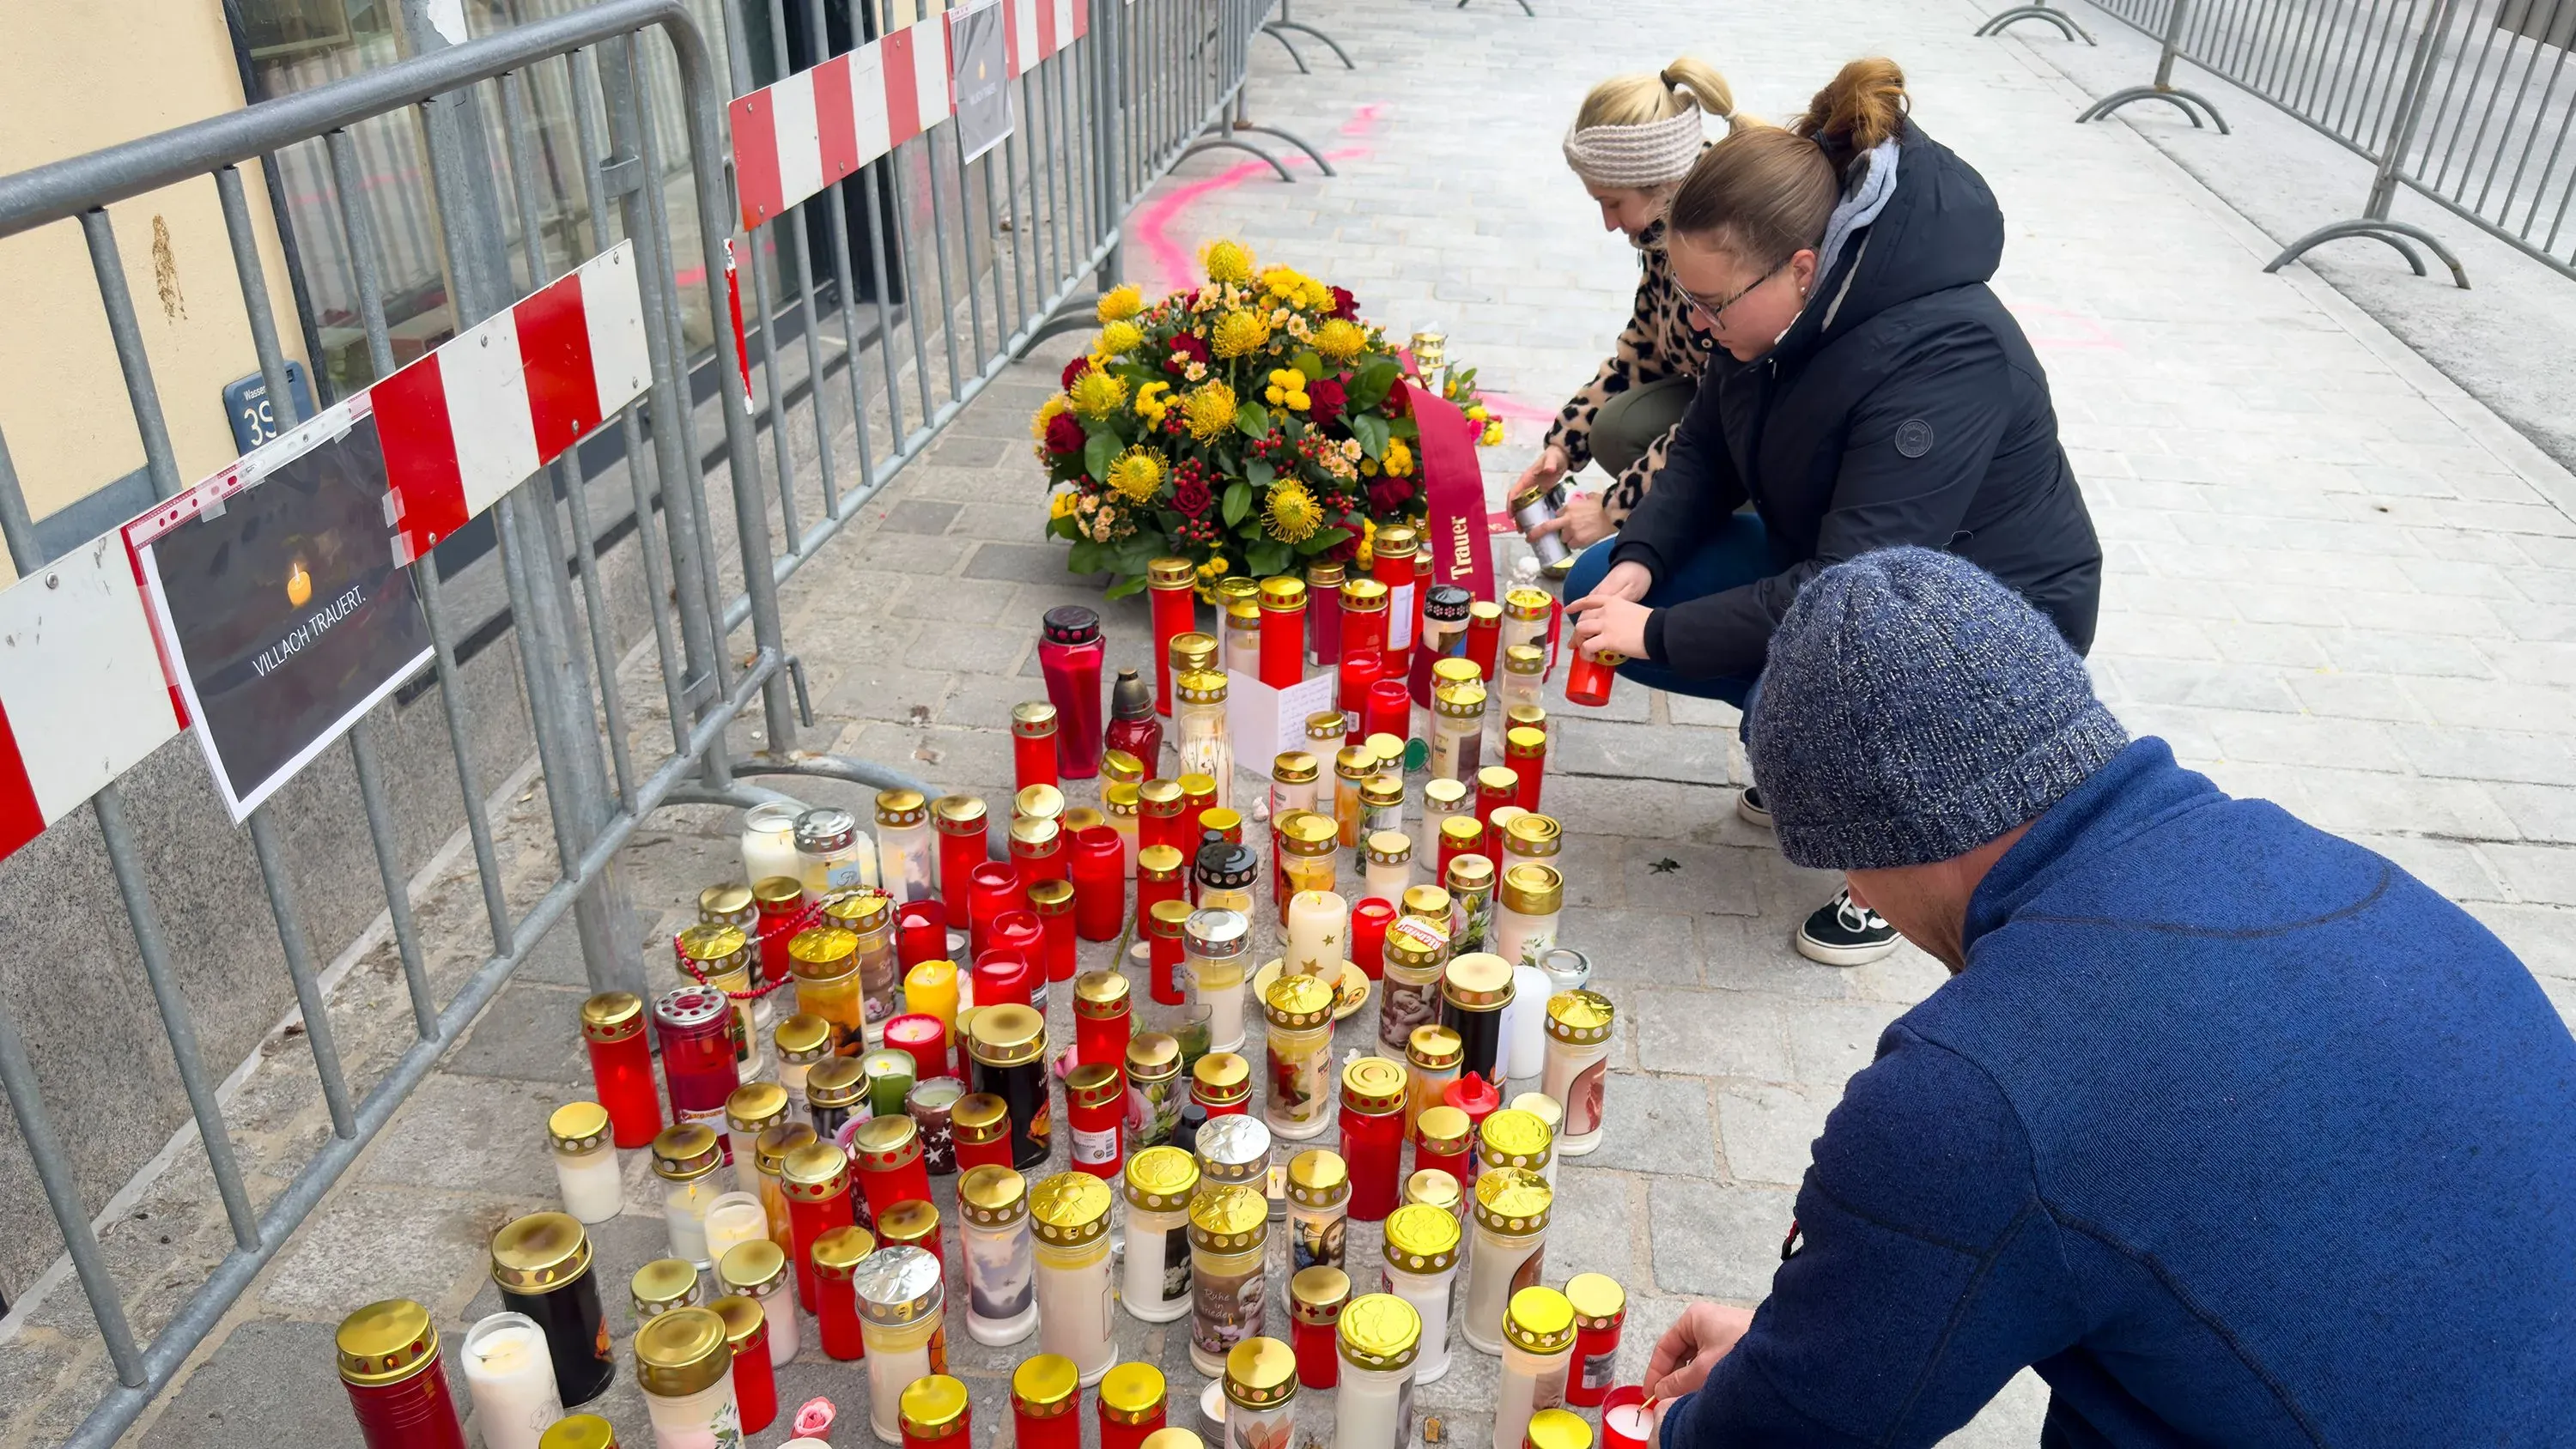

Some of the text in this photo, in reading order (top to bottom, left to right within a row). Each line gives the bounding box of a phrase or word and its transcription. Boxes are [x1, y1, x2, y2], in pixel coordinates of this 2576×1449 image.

[1450, 516, 1473, 580] Trauer
[252, 585, 366, 676] VILLACH TRAUERT.
[1204, 1288, 1230, 1301] Ruhe
